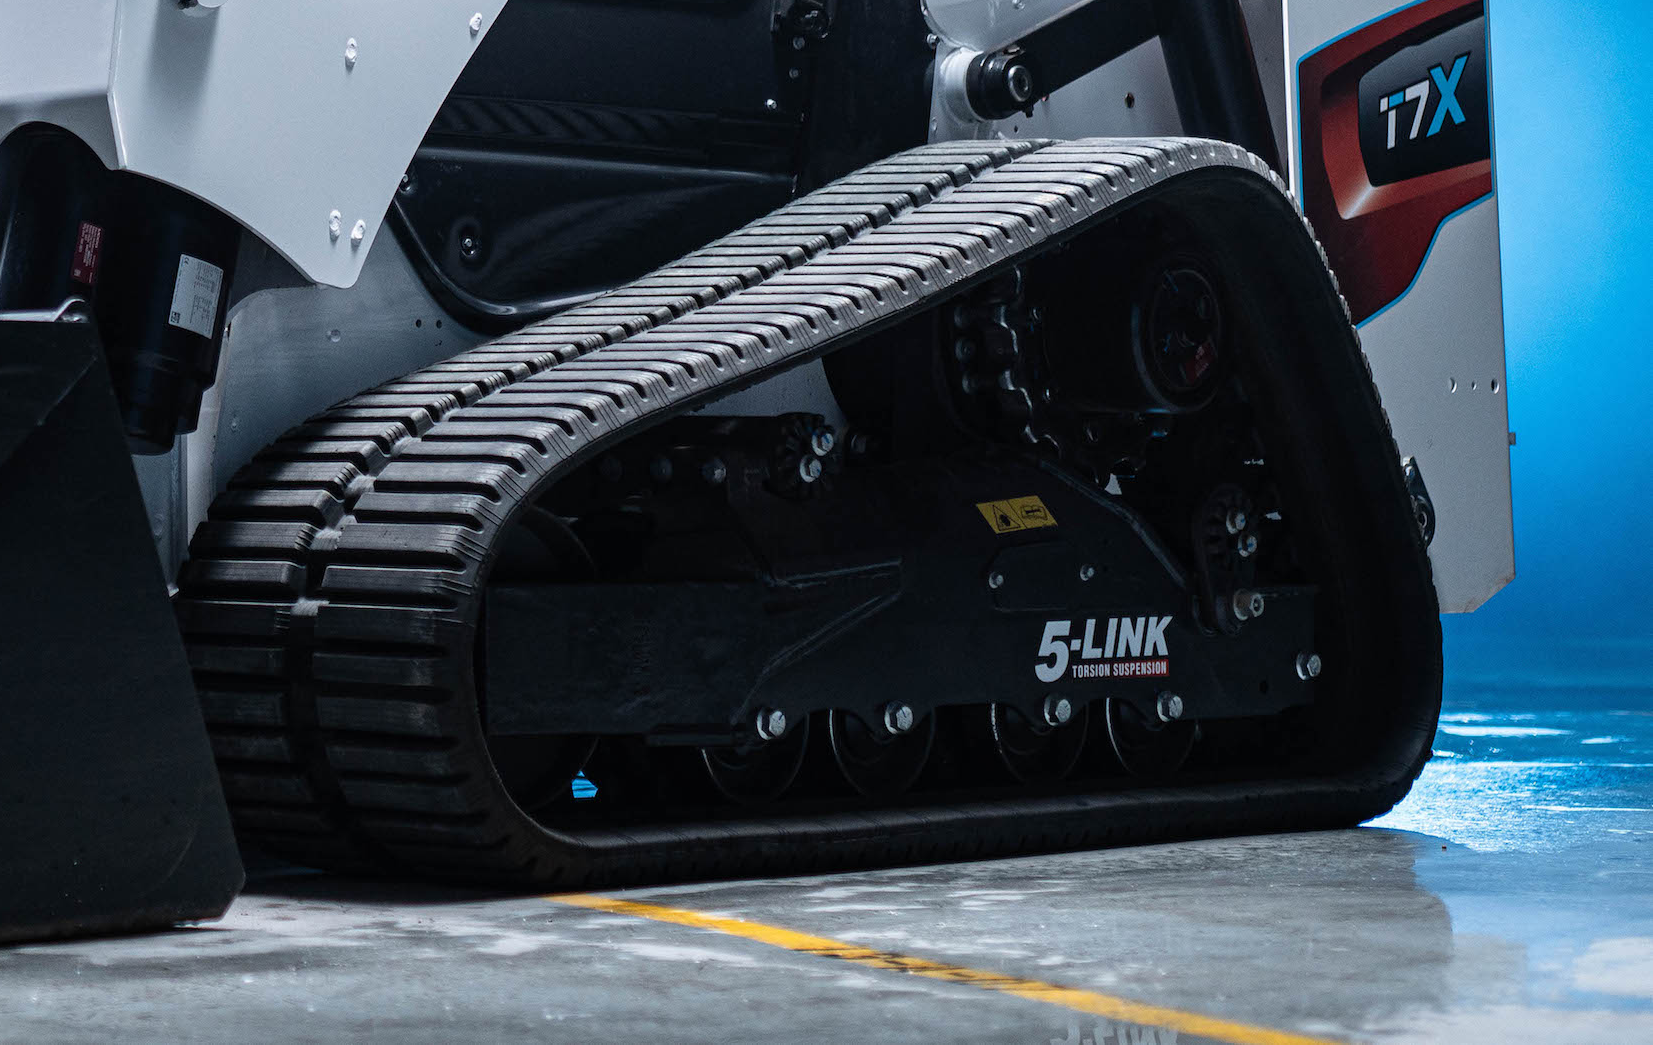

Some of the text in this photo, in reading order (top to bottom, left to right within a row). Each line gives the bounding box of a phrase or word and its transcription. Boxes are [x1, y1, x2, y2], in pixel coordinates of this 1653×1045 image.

[1379, 54, 1469, 150] T7X
[1034, 615, 1174, 684] 5-LINK
[1072, 660, 1167, 679] TORSION SUSPENSION
